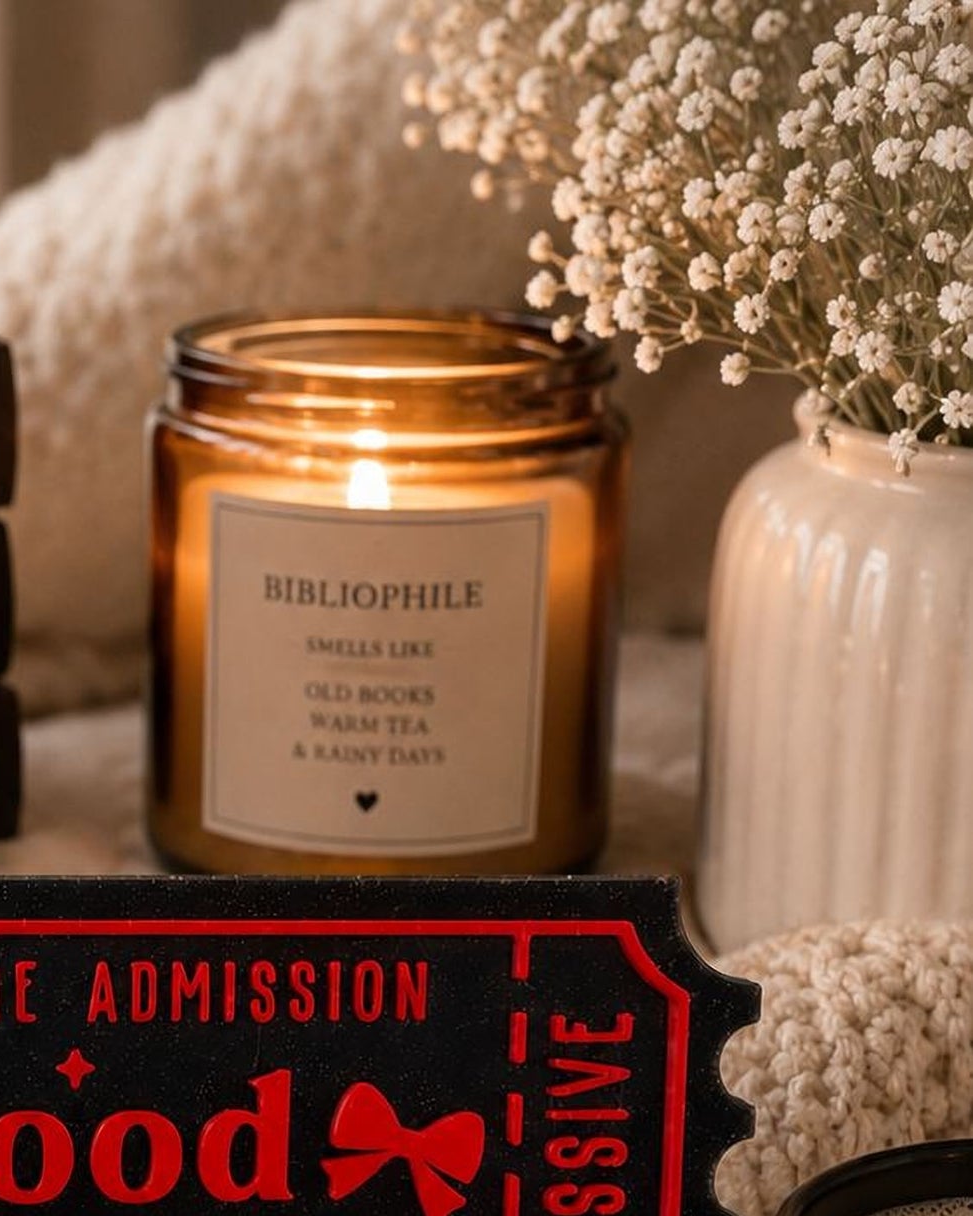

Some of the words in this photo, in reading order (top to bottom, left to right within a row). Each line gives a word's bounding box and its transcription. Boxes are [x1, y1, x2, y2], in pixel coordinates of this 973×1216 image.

[262, 573, 484, 611] BIBLIOPHILE
[305, 637, 383, 659] SMELLS
[389, 640, 435, 659] LIKE
[304, 682, 352, 705] OLD
[358, 685, 436, 706] BOOKS
[310, 711, 379, 734] WARM
[386, 716, 430, 735] TEA
[292, 742, 307, 760] &
[313, 745, 382, 766] RAINY
[389, 747, 446, 766] DAYS
[87, 959, 429, 1024] ADMISSION
